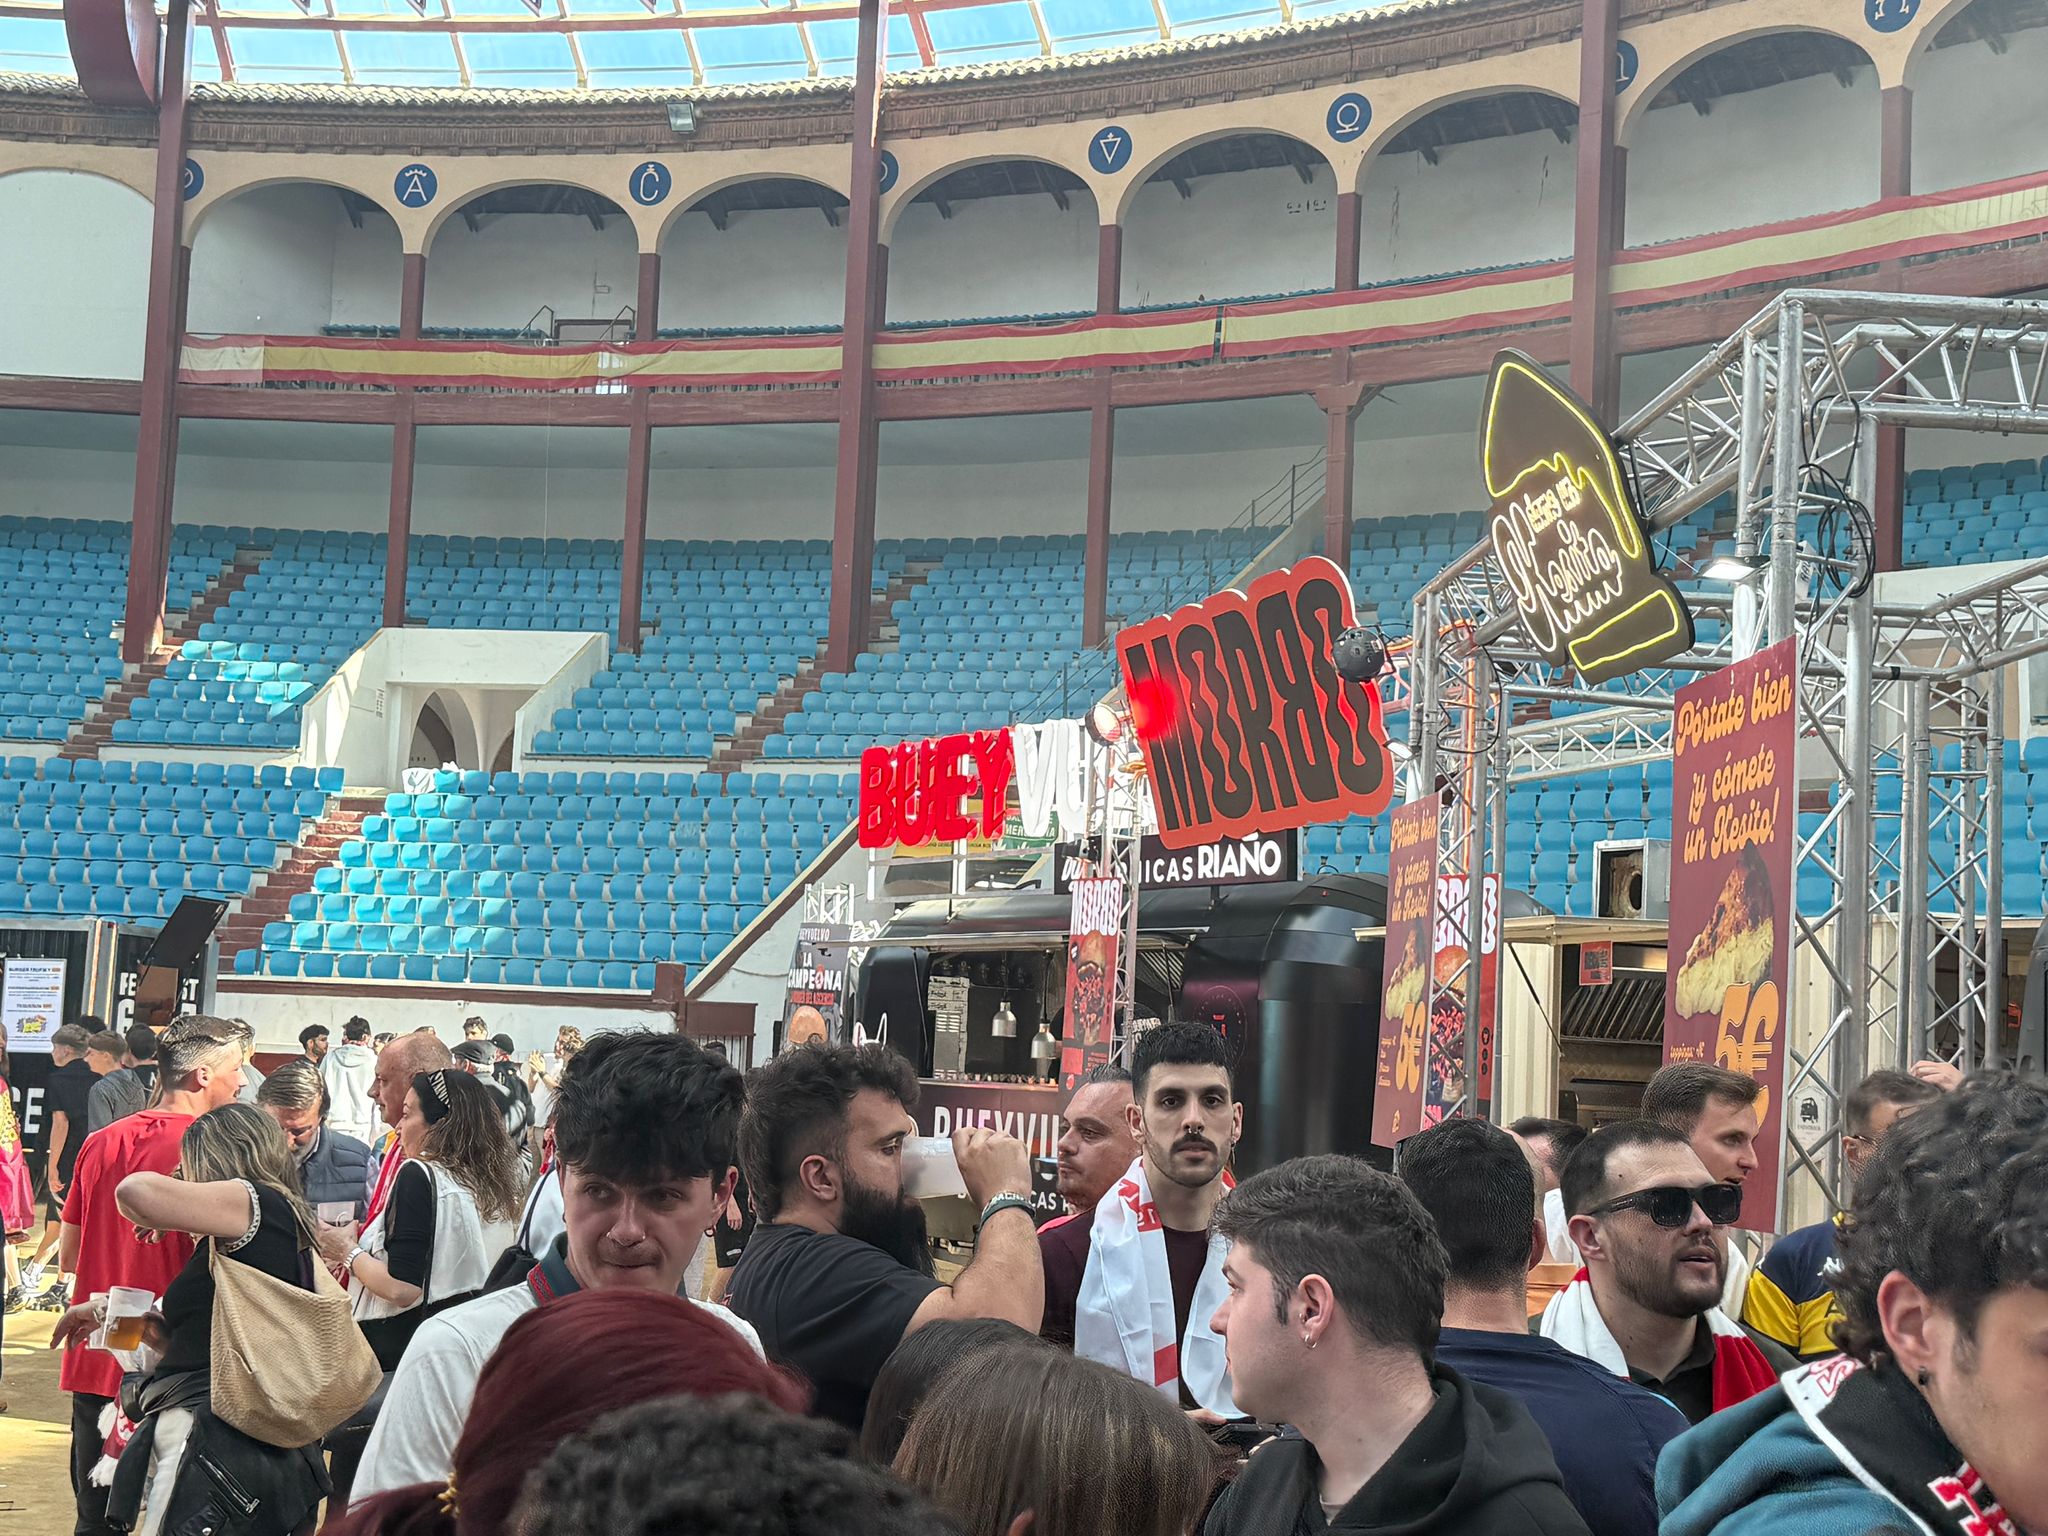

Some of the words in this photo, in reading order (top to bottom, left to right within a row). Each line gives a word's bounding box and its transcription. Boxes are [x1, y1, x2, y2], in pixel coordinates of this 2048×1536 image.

[1125, 578, 1384, 832] MORBO
[1675, 688, 1745, 757] Pórtate
[1751, 668, 1793, 725] bien
[1711, 743, 1776, 803] cómete
[1197, 832, 1283, 880] RIAÑO
[1683, 827, 1707, 865] un
[1070, 879, 1120, 937] MORBO
[802, 952, 813, 968] LA
